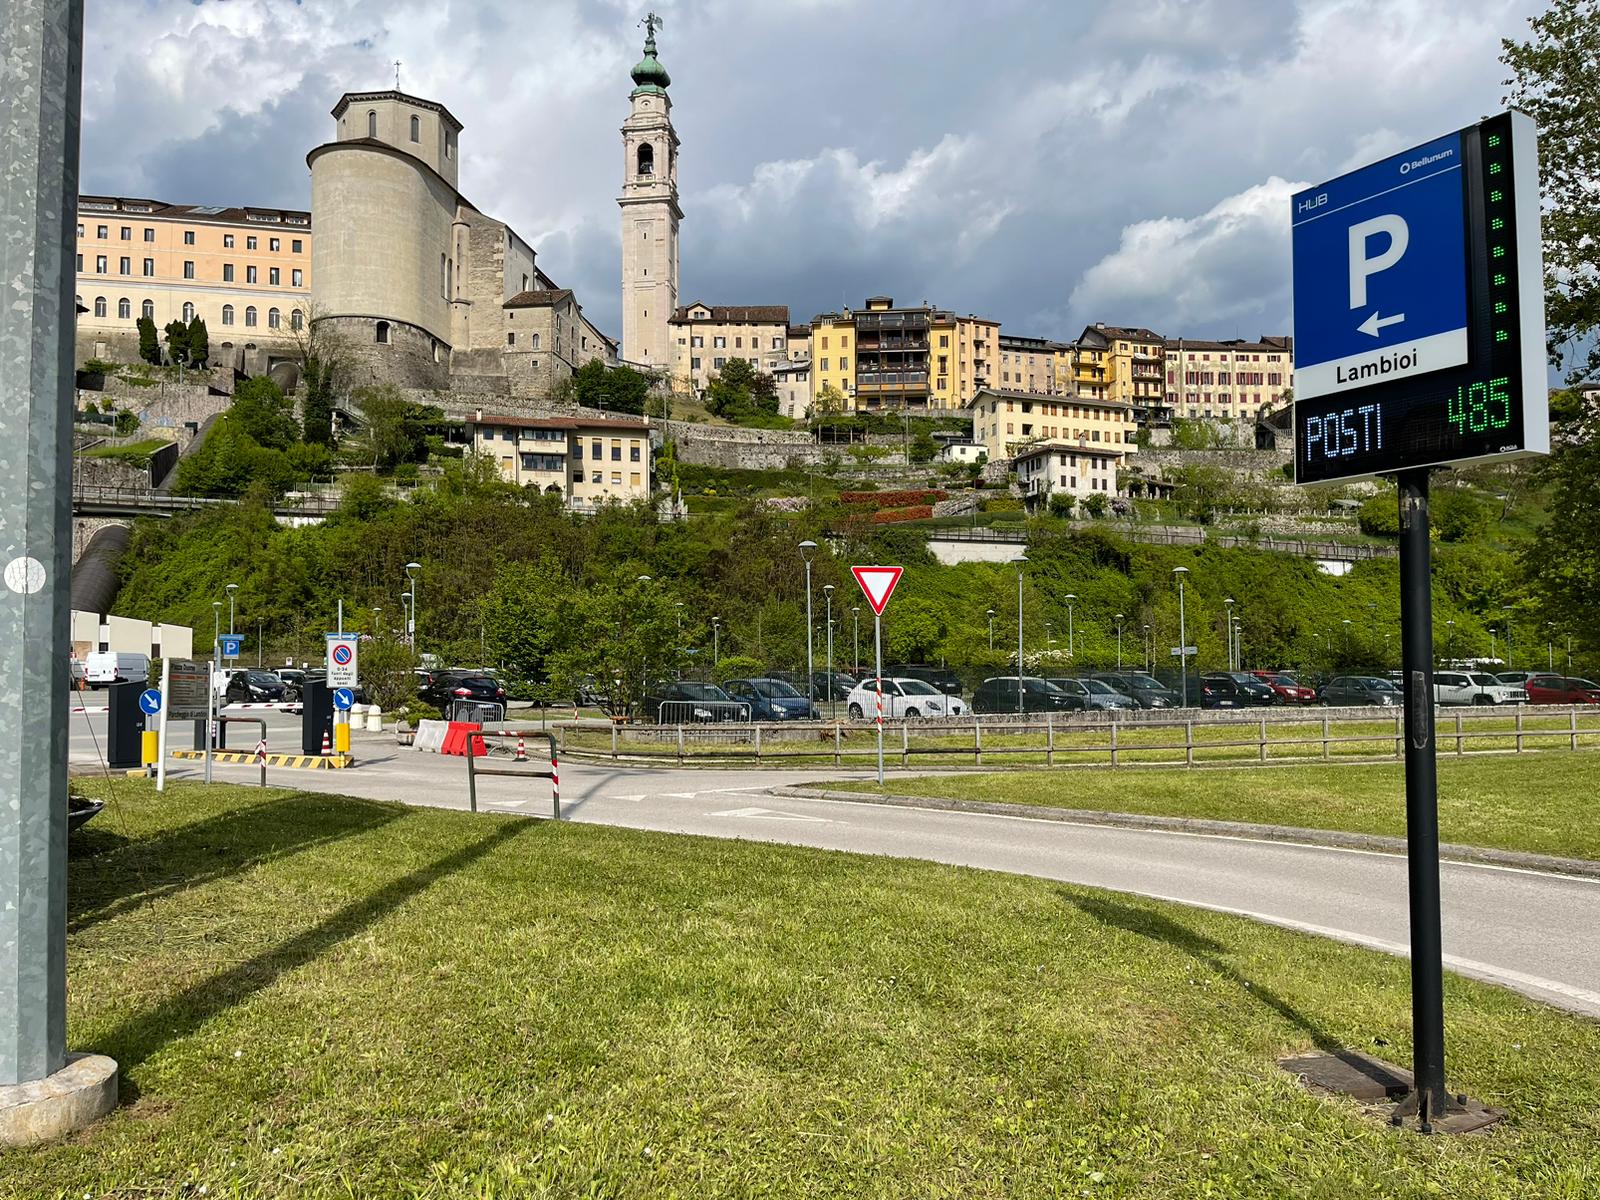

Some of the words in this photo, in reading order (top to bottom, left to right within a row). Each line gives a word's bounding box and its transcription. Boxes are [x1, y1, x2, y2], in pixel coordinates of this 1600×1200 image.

[1411, 149, 1453, 170] Bellunum
[1298, 193, 1328, 213] HUB
[1349, 214, 1409, 310] P
[1337, 348, 1417, 384] Lambioi
[1307, 403, 1382, 461] POSTI
[1448, 377, 1510, 435] 485
[226, 642, 236, 654] P
